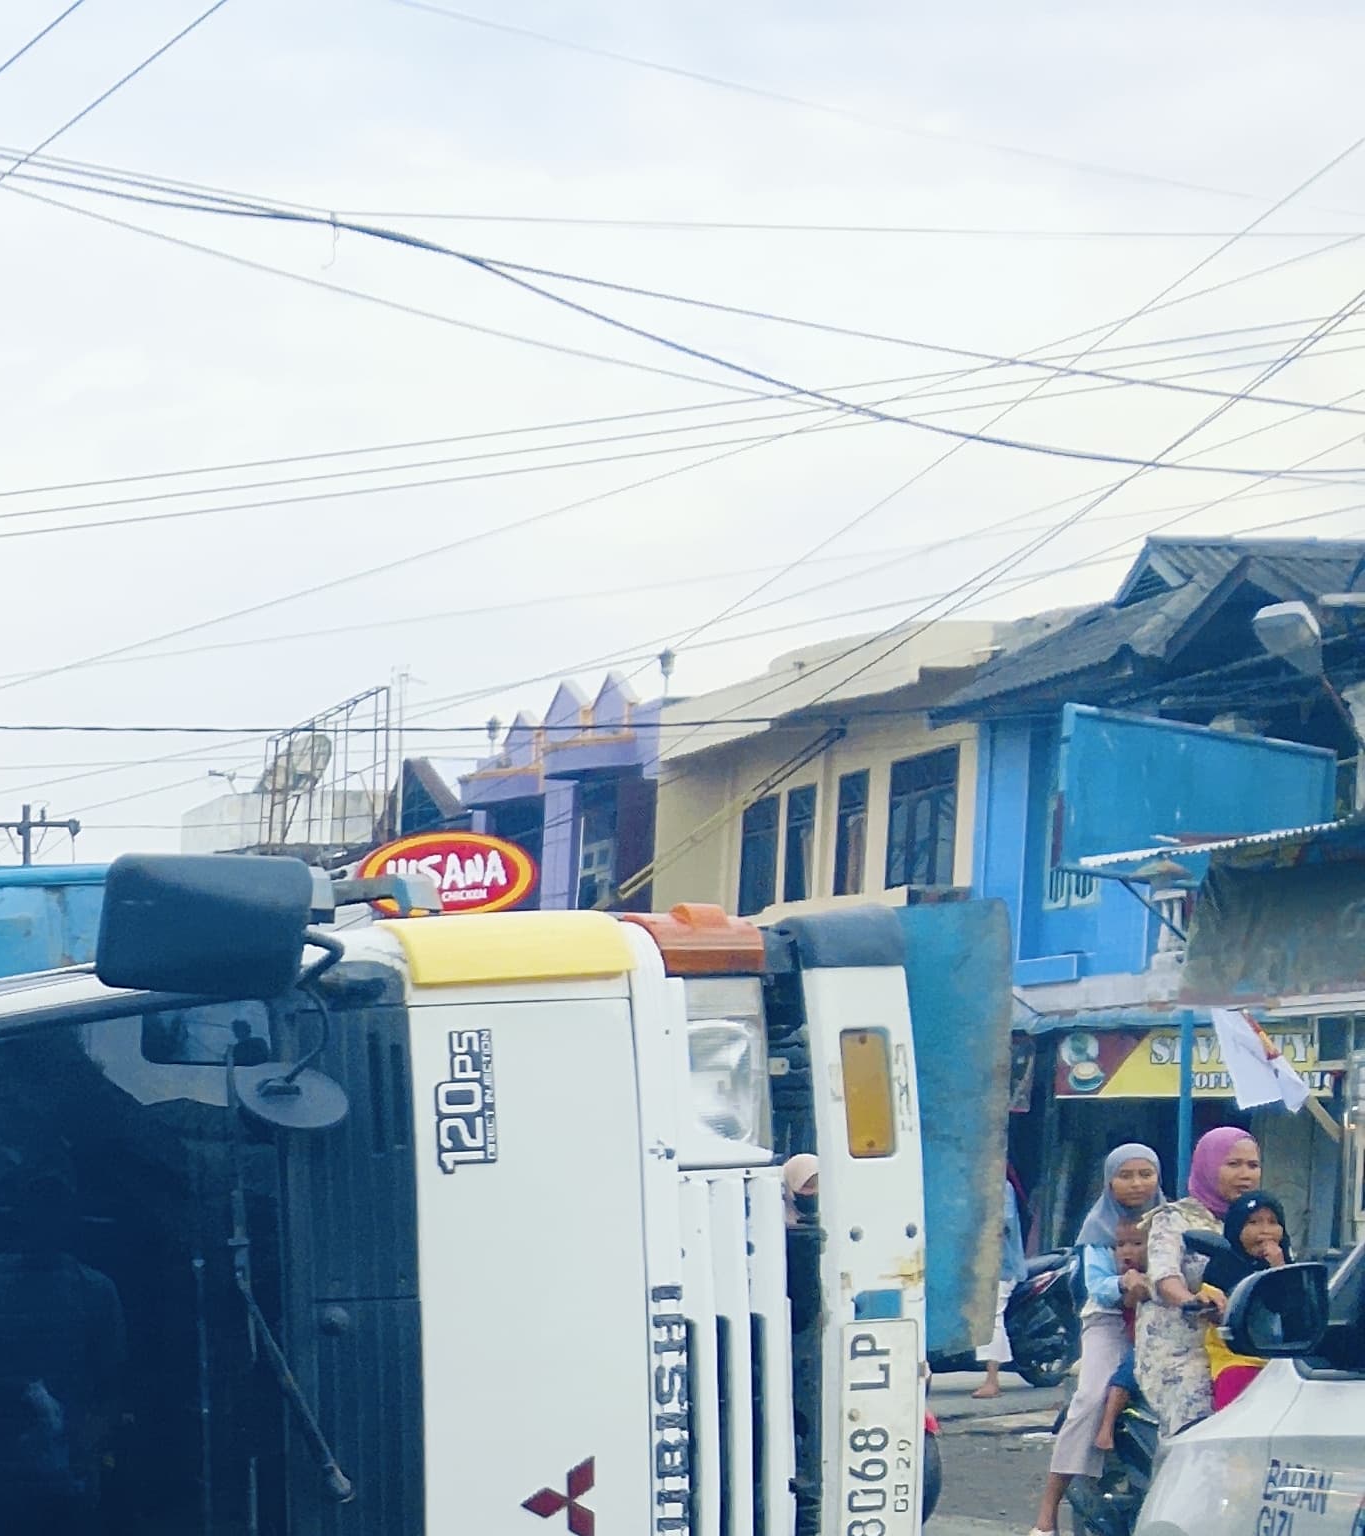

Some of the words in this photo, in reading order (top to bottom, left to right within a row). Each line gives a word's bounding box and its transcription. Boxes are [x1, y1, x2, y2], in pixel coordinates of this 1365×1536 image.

[479, 1029, 495, 1103] INJECTION
[483, 1109, 498, 1160] DIRECT
[848, 1331, 891, 1392] LP
[1262, 1458, 1334, 1516] BADAN
